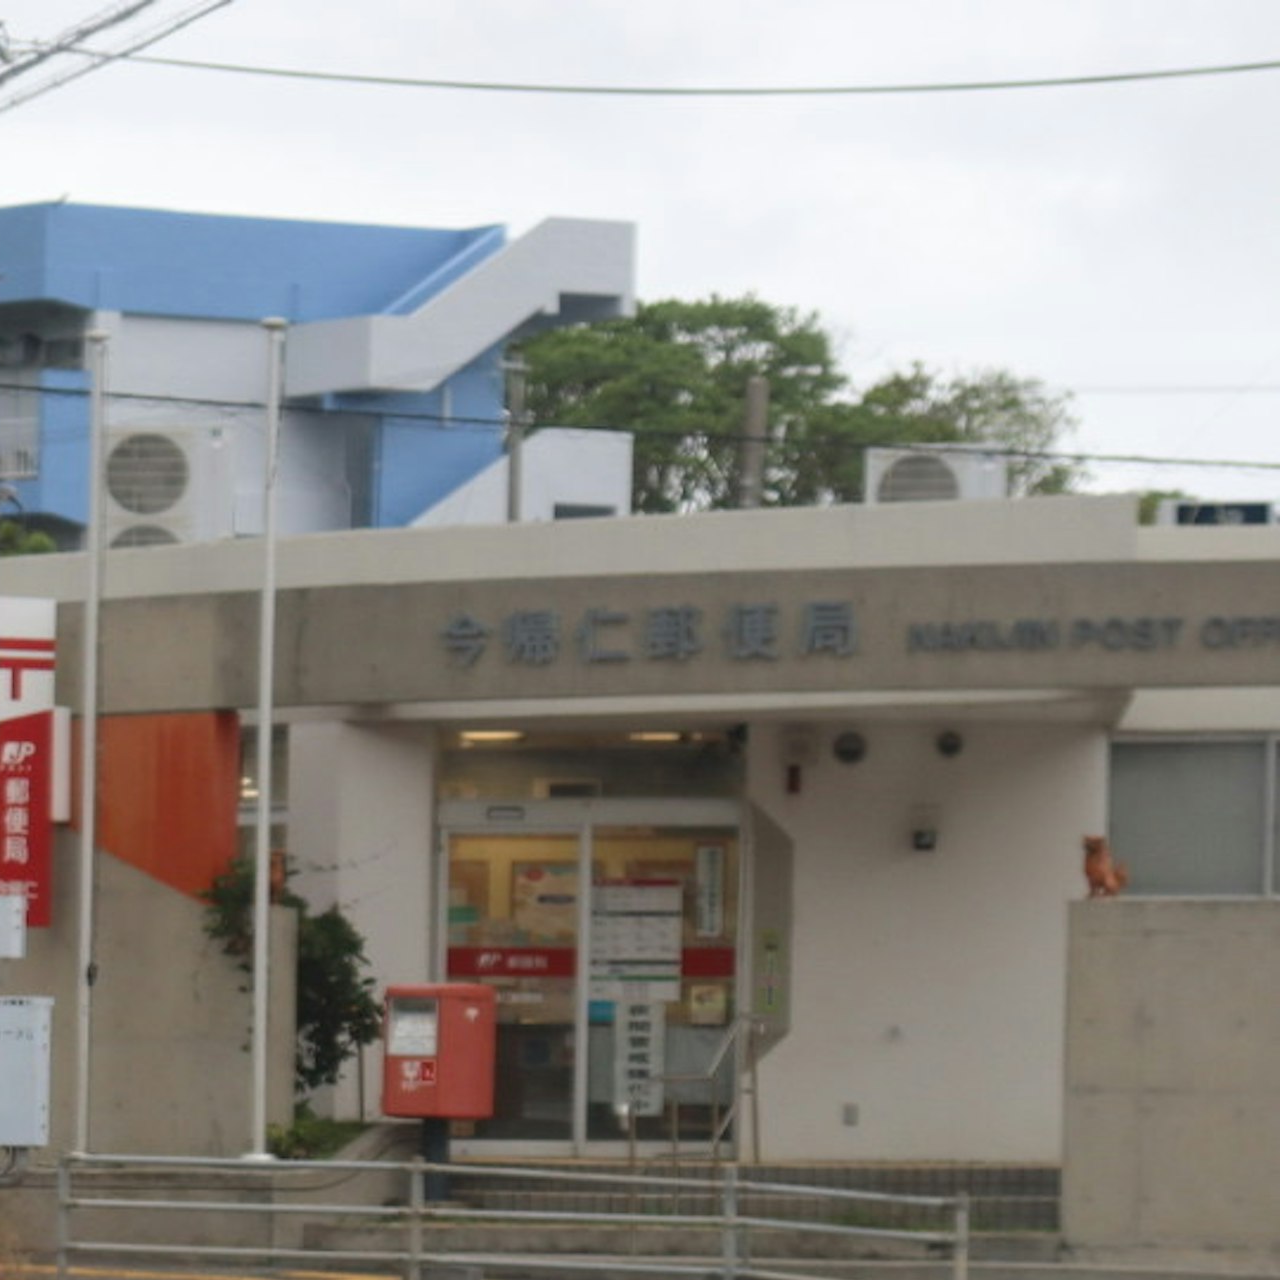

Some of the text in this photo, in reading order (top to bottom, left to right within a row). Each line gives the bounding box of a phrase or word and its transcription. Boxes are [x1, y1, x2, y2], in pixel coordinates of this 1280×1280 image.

[439, 601, 859, 668] 今帰仁郵便局
[1070, 616, 1185, 650] POST
[4, 777, 30, 864] 郵便局
